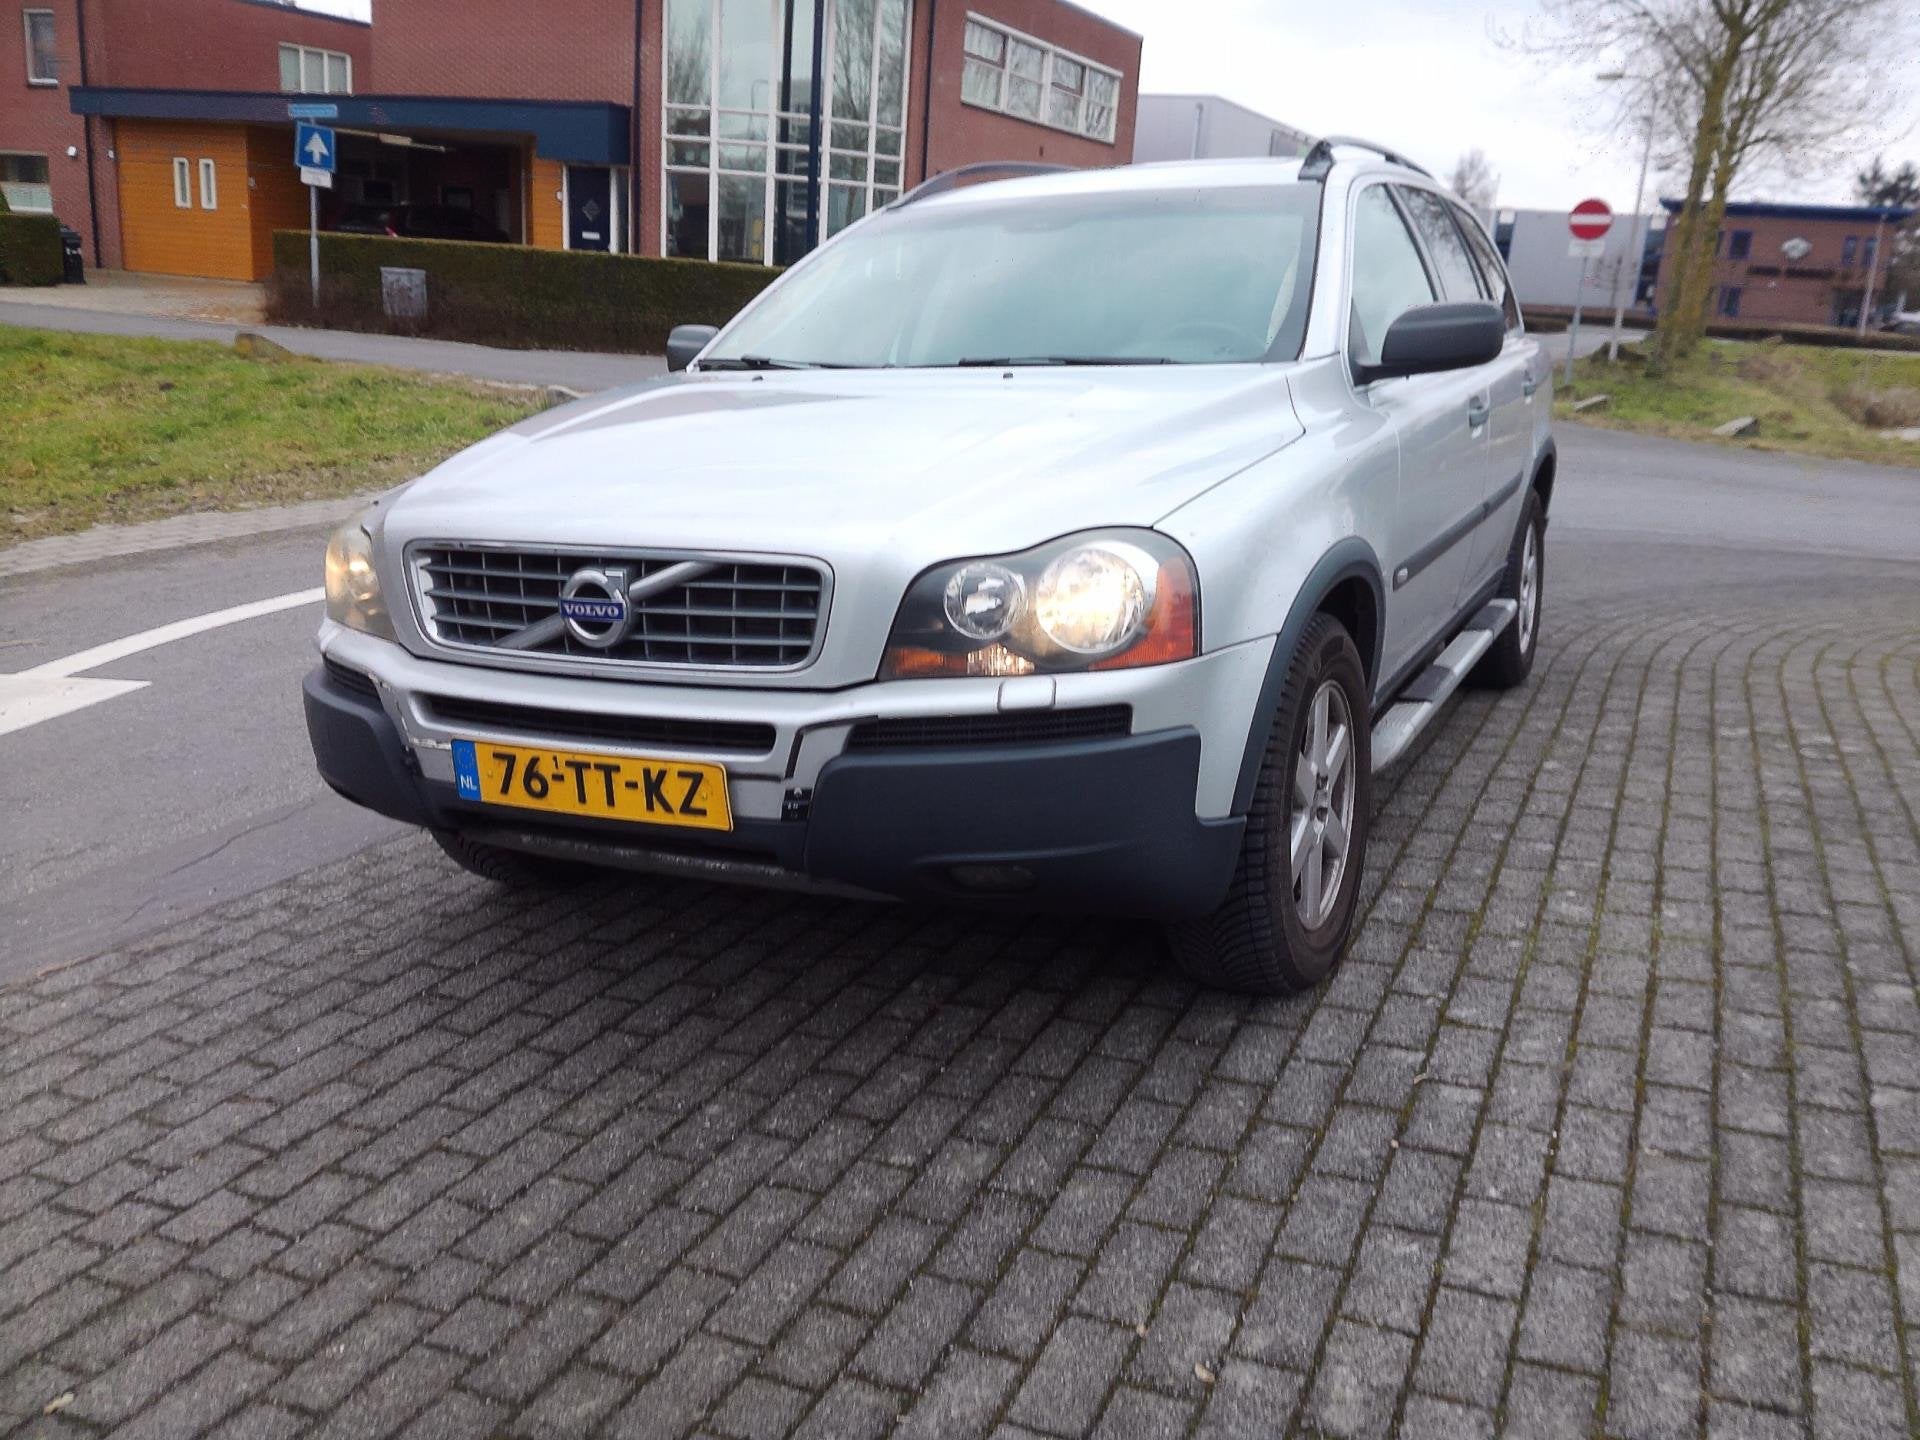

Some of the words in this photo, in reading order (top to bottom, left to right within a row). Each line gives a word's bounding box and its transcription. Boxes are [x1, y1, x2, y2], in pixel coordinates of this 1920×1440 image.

[563, 603, 619, 618] VOLVO
[460, 774, 477, 790] NL
[492, 752, 707, 816] 76-TT-KZ
